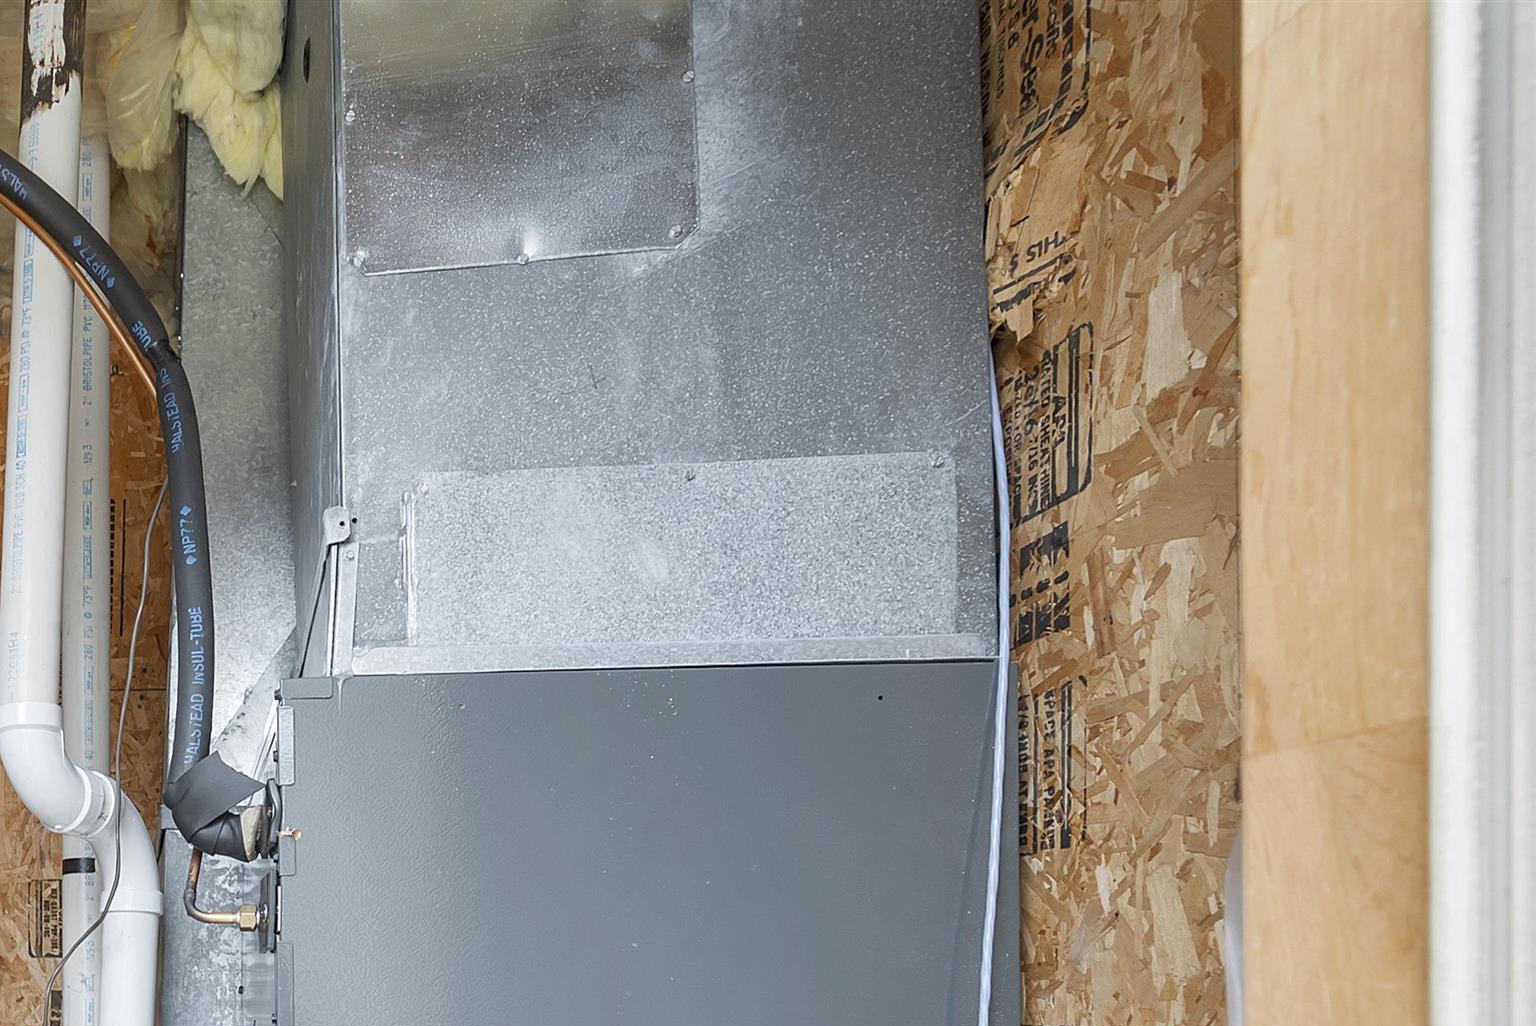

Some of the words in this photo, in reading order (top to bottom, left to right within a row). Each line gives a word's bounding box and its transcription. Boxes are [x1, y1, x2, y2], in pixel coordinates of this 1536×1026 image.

[79, 246, 111, 281] NP77
[82, 316, 93, 332] PVC
[82, 337, 93, 392] BRISTOLPIPE
[180, 519, 197, 554] NP77
[188, 607, 205, 685] INSUL-TUBE
[183, 693, 205, 763] HALSTEAD
